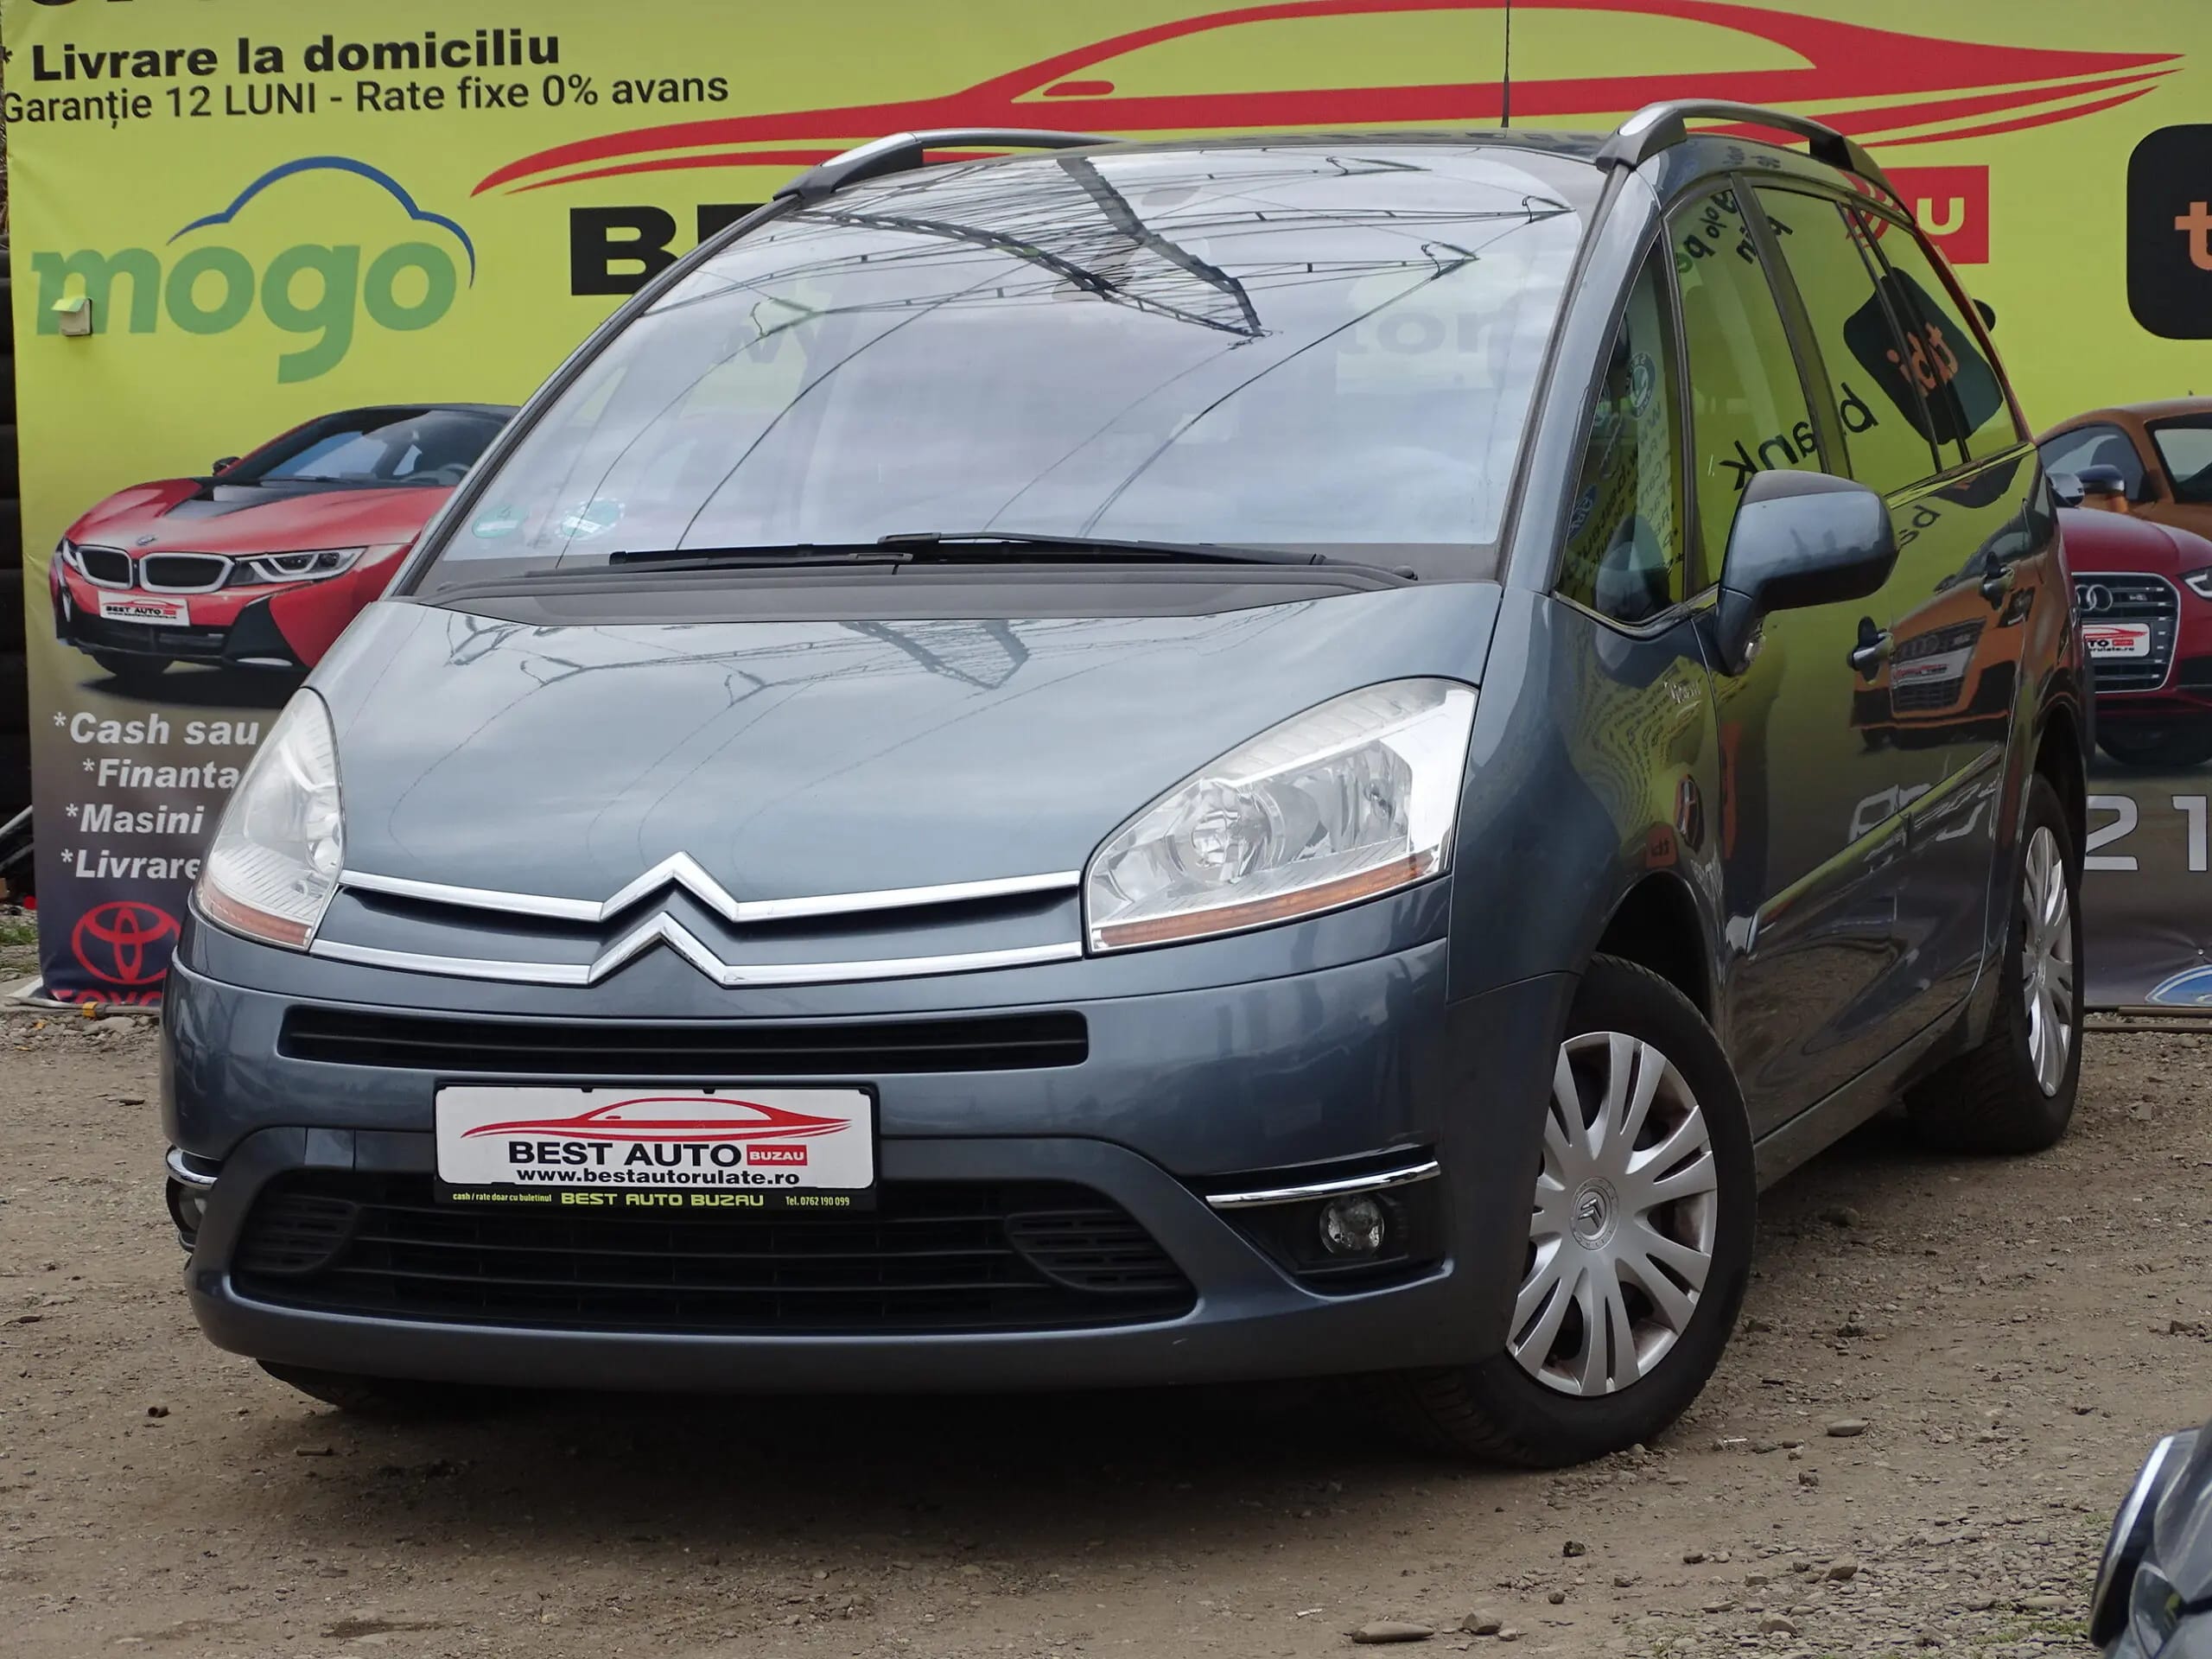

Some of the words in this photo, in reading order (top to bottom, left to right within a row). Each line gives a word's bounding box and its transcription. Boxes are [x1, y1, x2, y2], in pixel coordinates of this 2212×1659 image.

[33, 44, 218, 81] Livrare
[238, 37, 283, 74] la
[303, 28, 559, 72] domiciliu
[166, 86, 212, 118] 12
[226, 82, 315, 116] LUNI
[357, 80, 445, 111] Rate
[457, 75, 530, 109] fixe
[543, 74, 599, 106] 0%
[612, 76, 728, 104] avans
[31, 242, 456, 385] mogo
[184, 721, 259, 745] sau
[509, 1141, 613, 1165] BEST
[624, 1143, 741, 1166] AUTO
[749, 1151, 804, 1160] BUZAU
[517, 1168, 800, 1185] www.bestautorulate.ro
[453, 1192, 470, 1201] cash
[475, 1192, 490, 1201] rate
[492, 1192, 508, 1201] doar
[519, 1192, 552, 1202] buletinul
[562, 1192, 618, 1205] BEST
[626, 1193, 683, 1205] AUTO
[691, 1194, 764, 1206] BUZAU
[785, 1196, 799, 1206] Tel.
[800, 1196, 819, 1206] 0762
[821, 1197, 834, 1206] 190
[835, 1197, 849, 1206] 099
